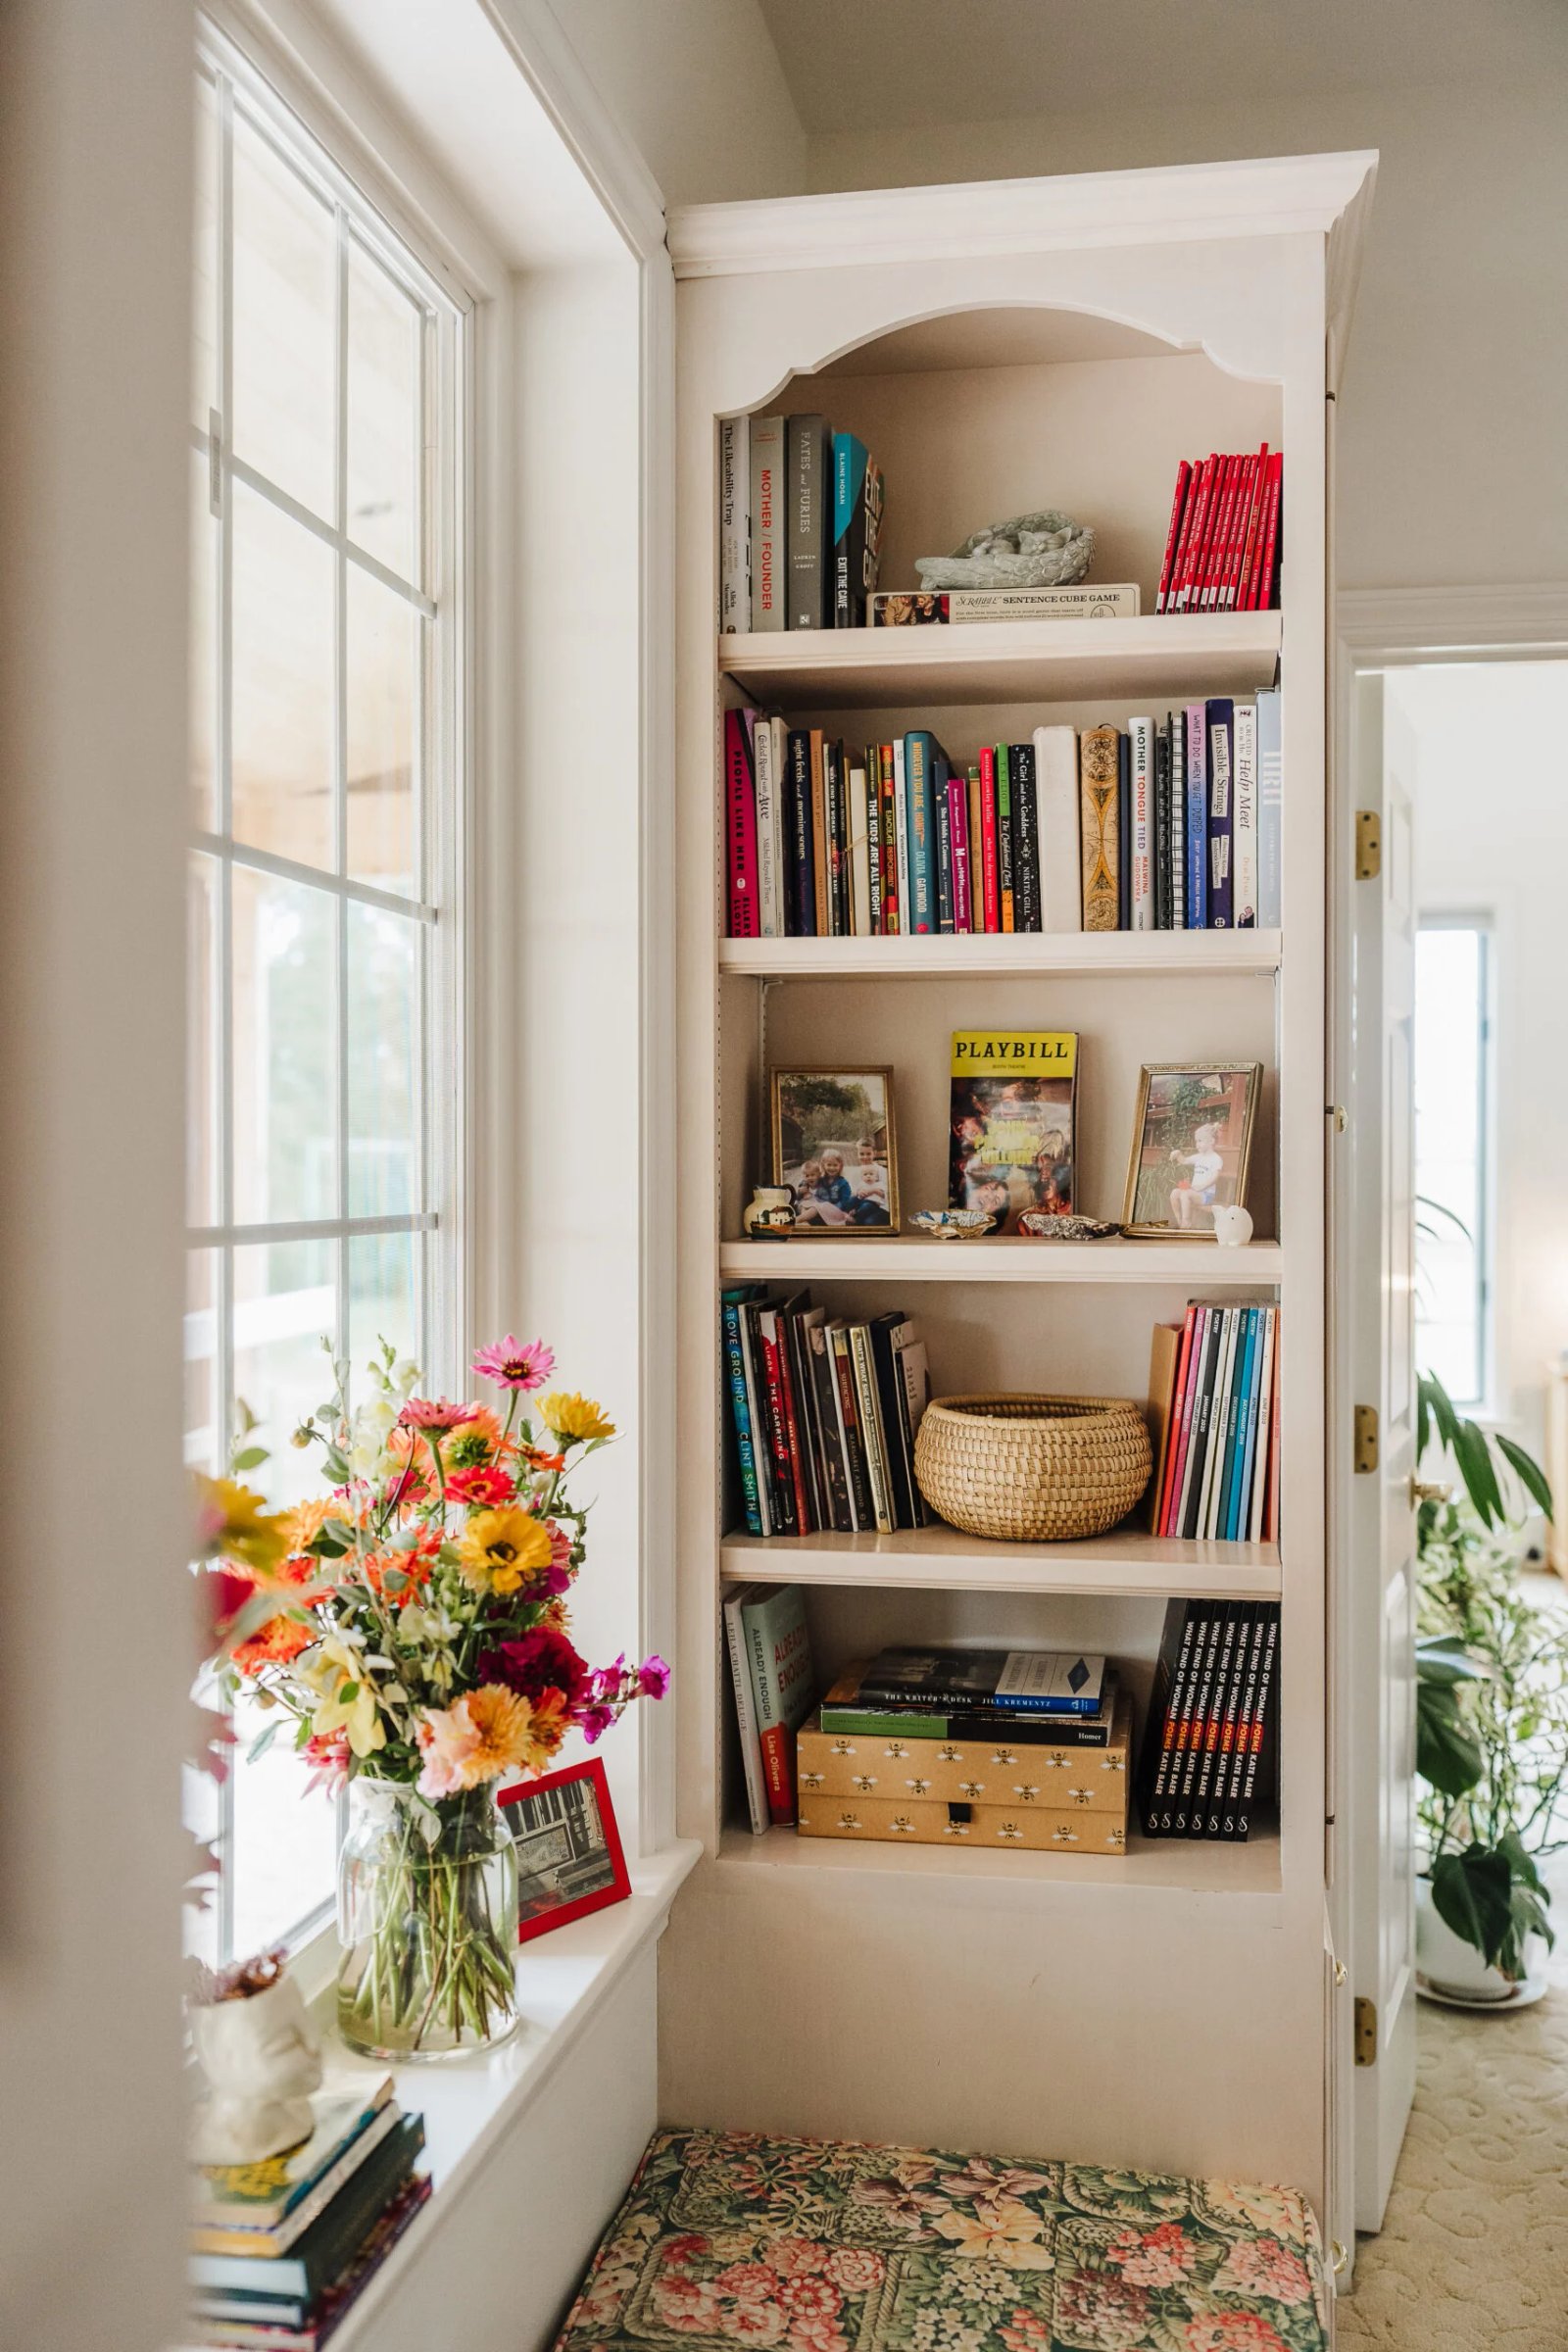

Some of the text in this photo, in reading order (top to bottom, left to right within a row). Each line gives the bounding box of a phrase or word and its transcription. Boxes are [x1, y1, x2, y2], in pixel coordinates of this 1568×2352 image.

[801, 432, 809, 469] FATES
[723, 424, 734, 525] The Likeability Trap
[800, 488, 809, 533] FURIES
[761, 470, 771, 610] MOTHER FOUNDER
[837, 558, 847, 608] EXIT THE CAVE
[793, 739, 805, 760] night
[912, 742, 923, 776] WHOEVER
[1193, 748, 1200, 758] DO
[734, 751, 743, 801] PEOPLE
[759, 758, 767, 780] Round
[796, 761, 805, 782] feeds
[914, 778, 923, 792] YOU
[1214, 728, 1227, 814] Invisible Strings
[759, 793, 770, 820] Awe
[913, 794, 923, 810] ARE,
[1238, 760, 1250, 829] Help Meet
[735, 808, 744, 837] LIKE
[795, 801, 806, 834] morning
[869, 819, 878, 843] KIDS
[1192, 808, 1202, 833] DUMPED
[1002, 833, 1011, 868] Confidential
[870, 866, 879, 884] ALL
[916, 852, 926, 912] OLIVIA GATWOOD
[1004, 870, 1012, 887] Clerk
[871, 886, 880, 915] RIGHT
[956, 1043, 1068, 1058] PLAYBILL
[725, 1305, 744, 1402] ABOVE GROUND
[840, 1374, 851, 1408] SURFACING
[856, 1339, 871, 1414] THAT'S WHAT SHE SAID
[772, 1407, 784, 1460] CARRYING
[740, 1432, 755, 1511] CLINT SMITH
[849, 1434, 863, 1507] MARGARET ATWOOD
[726, 1622, 747, 1732] LEILA CHATTI DELUGE
[752, 1629, 772, 1720] ALREADY ENOUGH
[906, 1694, 949, 1703] WRITER'S
[1155, 1621, 1195, 1795] WHAT KIND OF WOMAN POEMS KATE BAER
[1199, 1622, 1235, 1795] WHAT KIND OF WOMAN POEMS KATE BAER
[1244, 1623, 1277, 1797] WHAT KIND OF WOMAN POEMS KATE BAER
[767, 1735, 781, 1790] Lisa Olivera
